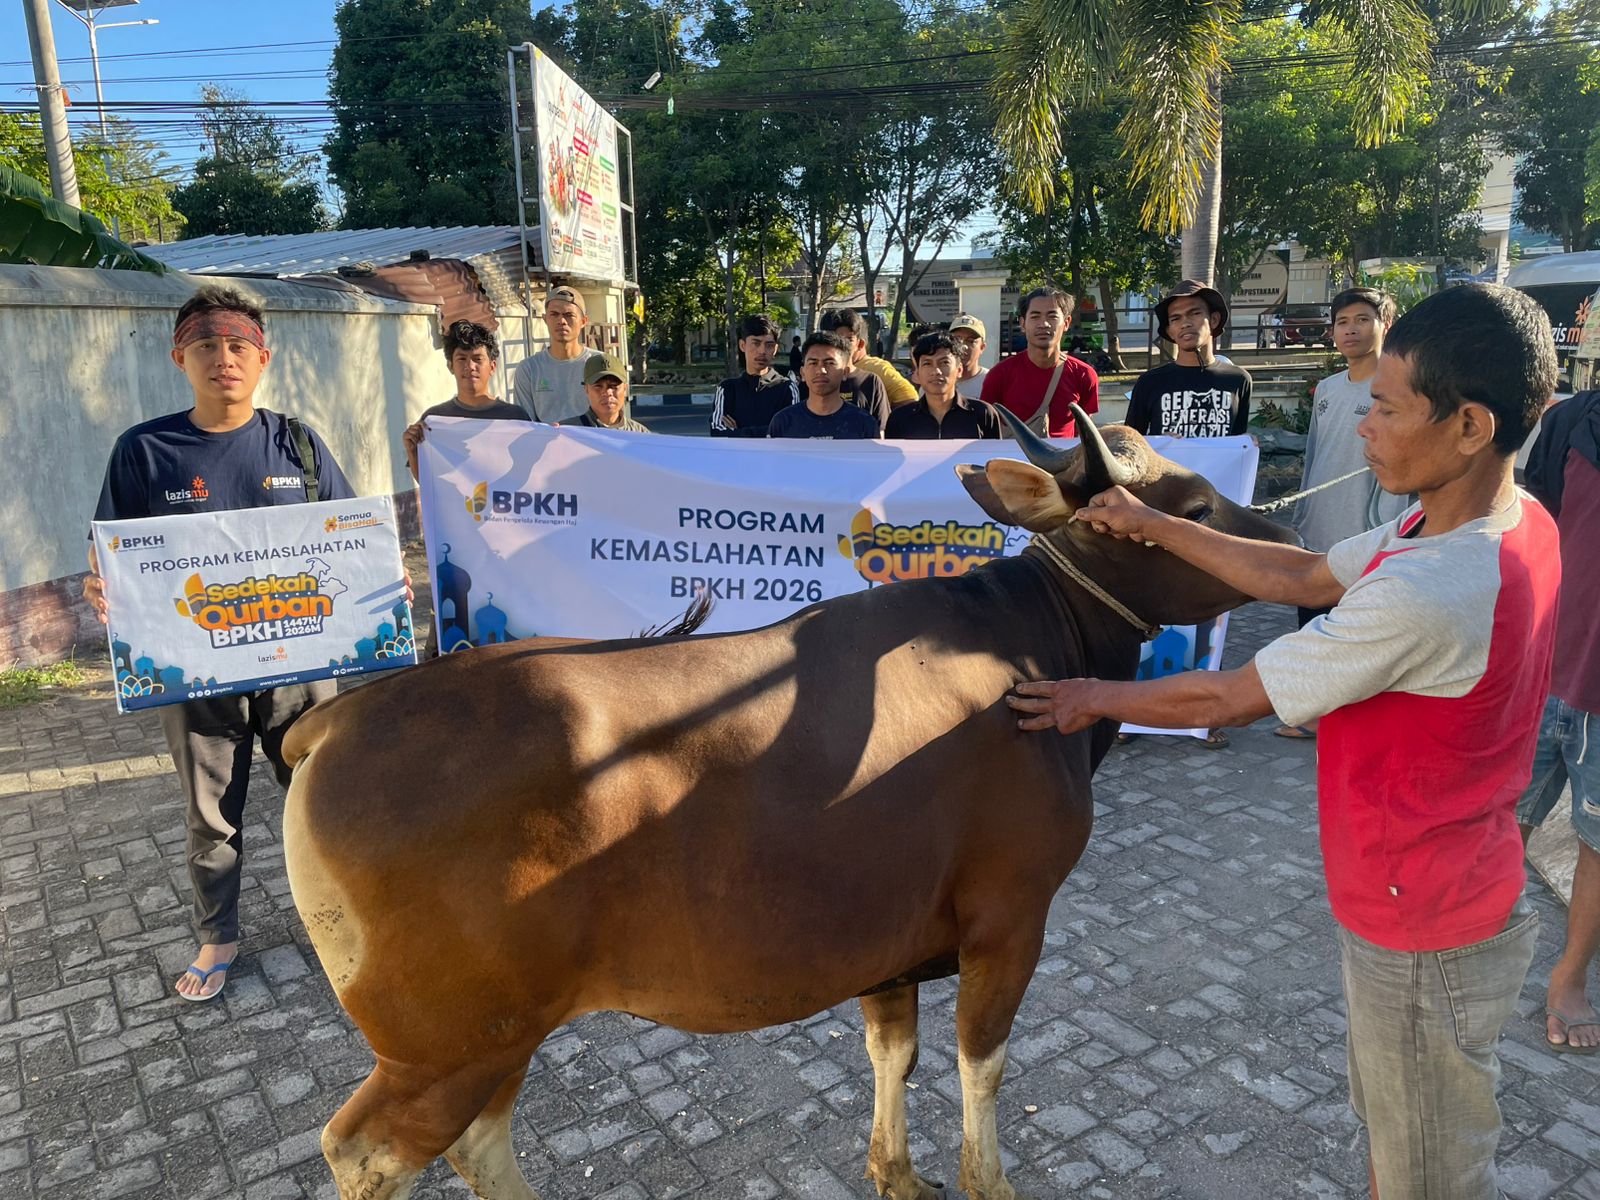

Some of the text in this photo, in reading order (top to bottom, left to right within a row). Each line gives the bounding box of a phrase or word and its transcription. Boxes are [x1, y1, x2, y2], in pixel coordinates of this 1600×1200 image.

[1161, 409, 1230, 426] GENERASI
[272, 476, 300, 486] BPKH
[165, 488, 209, 502] lazismu
[492, 490, 578, 517] BPKH
[338, 511, 372, 522] Semua
[679, 507, 825, 534] PROGRAM
[122, 534, 165, 549] BPKH
[140, 538, 366, 574] PROGRAM KEMASLAHATAN
[590, 537, 825, 568] KEMASLAHATAN
[670, 575, 823, 602] BPKH 2026
[198, 595, 333, 631] Qurban
[284, 615, 322, 628] 1447H/
[211, 619, 284, 648] BPKH
[285, 624, 321, 637] 2026M
[257, 652, 289, 664] lazismu
